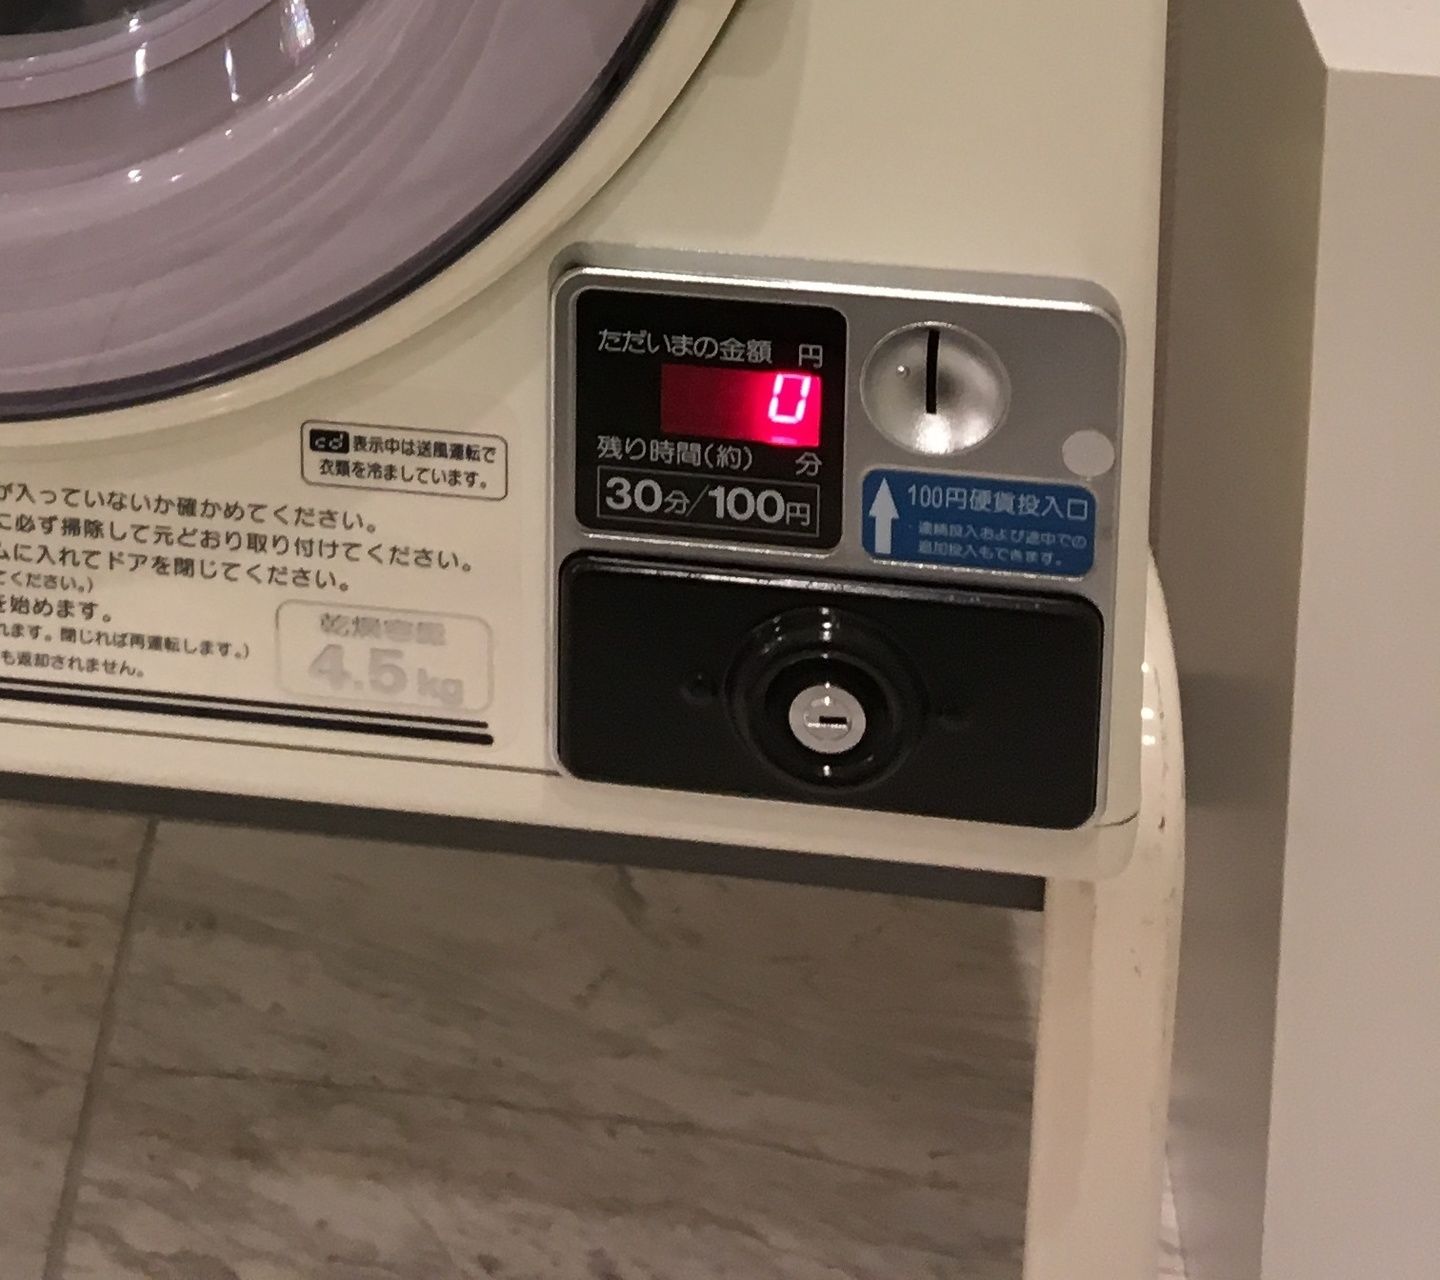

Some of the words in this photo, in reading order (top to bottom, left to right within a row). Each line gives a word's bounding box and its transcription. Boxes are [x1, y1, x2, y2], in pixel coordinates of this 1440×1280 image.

[597, 328, 773, 364] ただいまの金額
[798, 344, 823, 369] 円
[767, 373, 812, 425] 0
[352, 434, 497, 464] 表示中は送風運転で
[596, 434, 753, 471] 残り時間(約)
[795, 451, 823, 477] 分
[319, 458, 488, 490] 衣類を冷ましています。
[605, 476, 811, 527] 30分/100円
[908, 483, 1089, 522] 100円硬貨投入口
